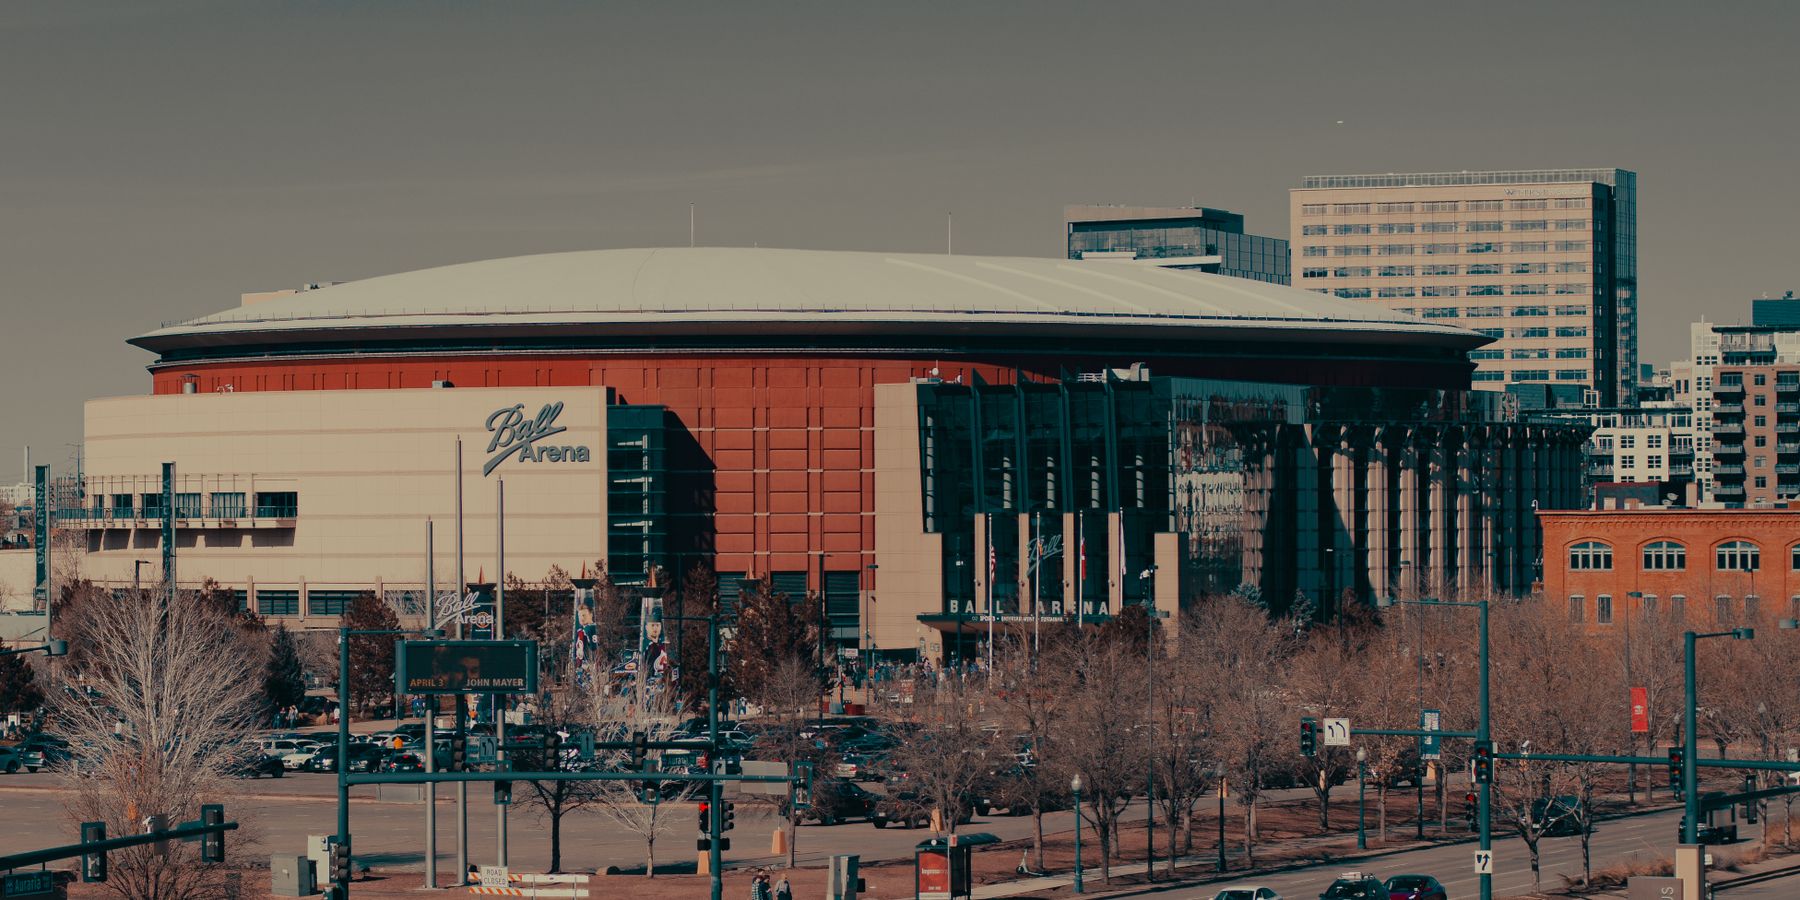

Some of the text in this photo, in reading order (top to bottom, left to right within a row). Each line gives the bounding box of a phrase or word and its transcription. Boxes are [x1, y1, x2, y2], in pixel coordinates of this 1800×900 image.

[483, 401, 567, 477] Ball
[519, 440, 590, 463] Arena
[36, 481, 45, 565] BALL ARENA
[434, 591, 481, 630] Ball
[950, 600, 1109, 616] BALL ARENA
[455, 613, 494, 625] Arena
[409, 678, 524, 688] APRIL 3 JOHN MAYER
[486, 868, 503, 877] ROAD
